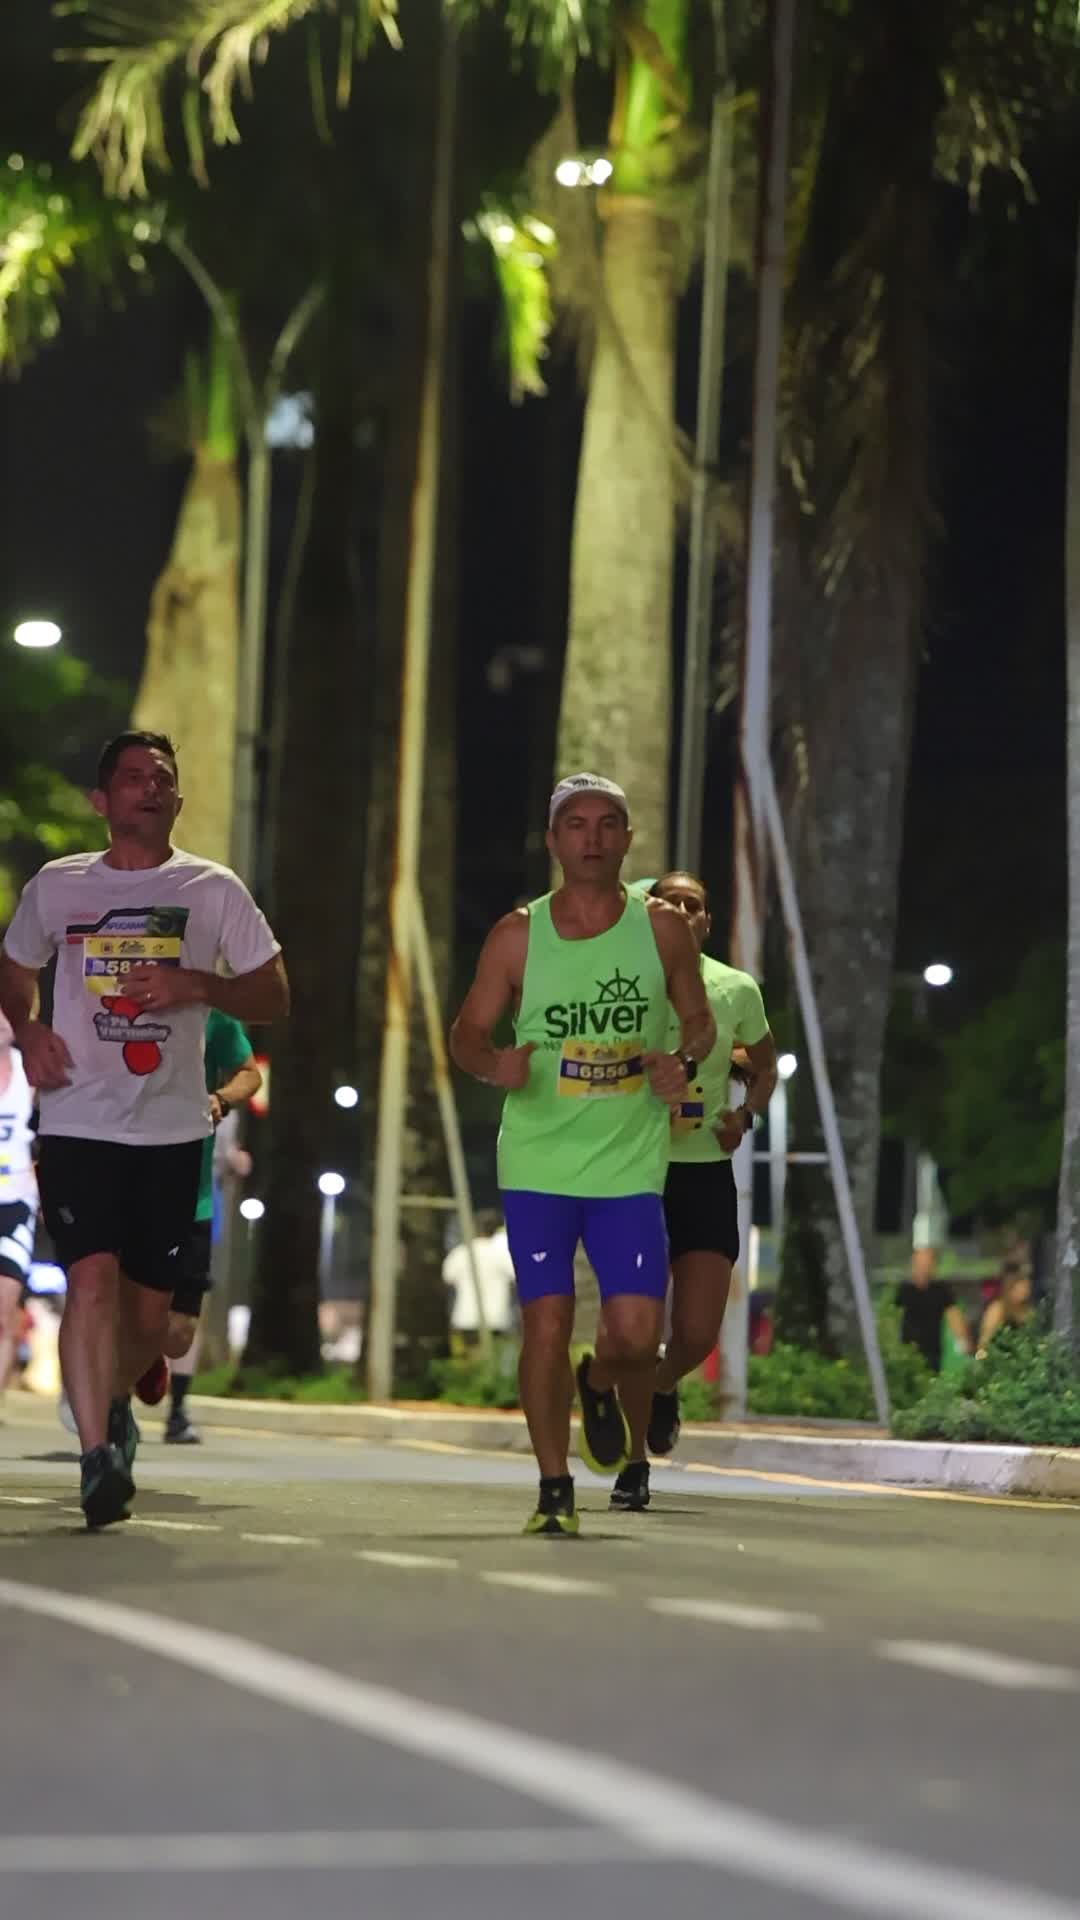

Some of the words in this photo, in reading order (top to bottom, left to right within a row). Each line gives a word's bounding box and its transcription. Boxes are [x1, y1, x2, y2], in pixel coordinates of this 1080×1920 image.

[106, 960, 158, 975] 58
[545, 1002, 648, 1038] Silver
[579, 1064, 628, 1080] 6556
